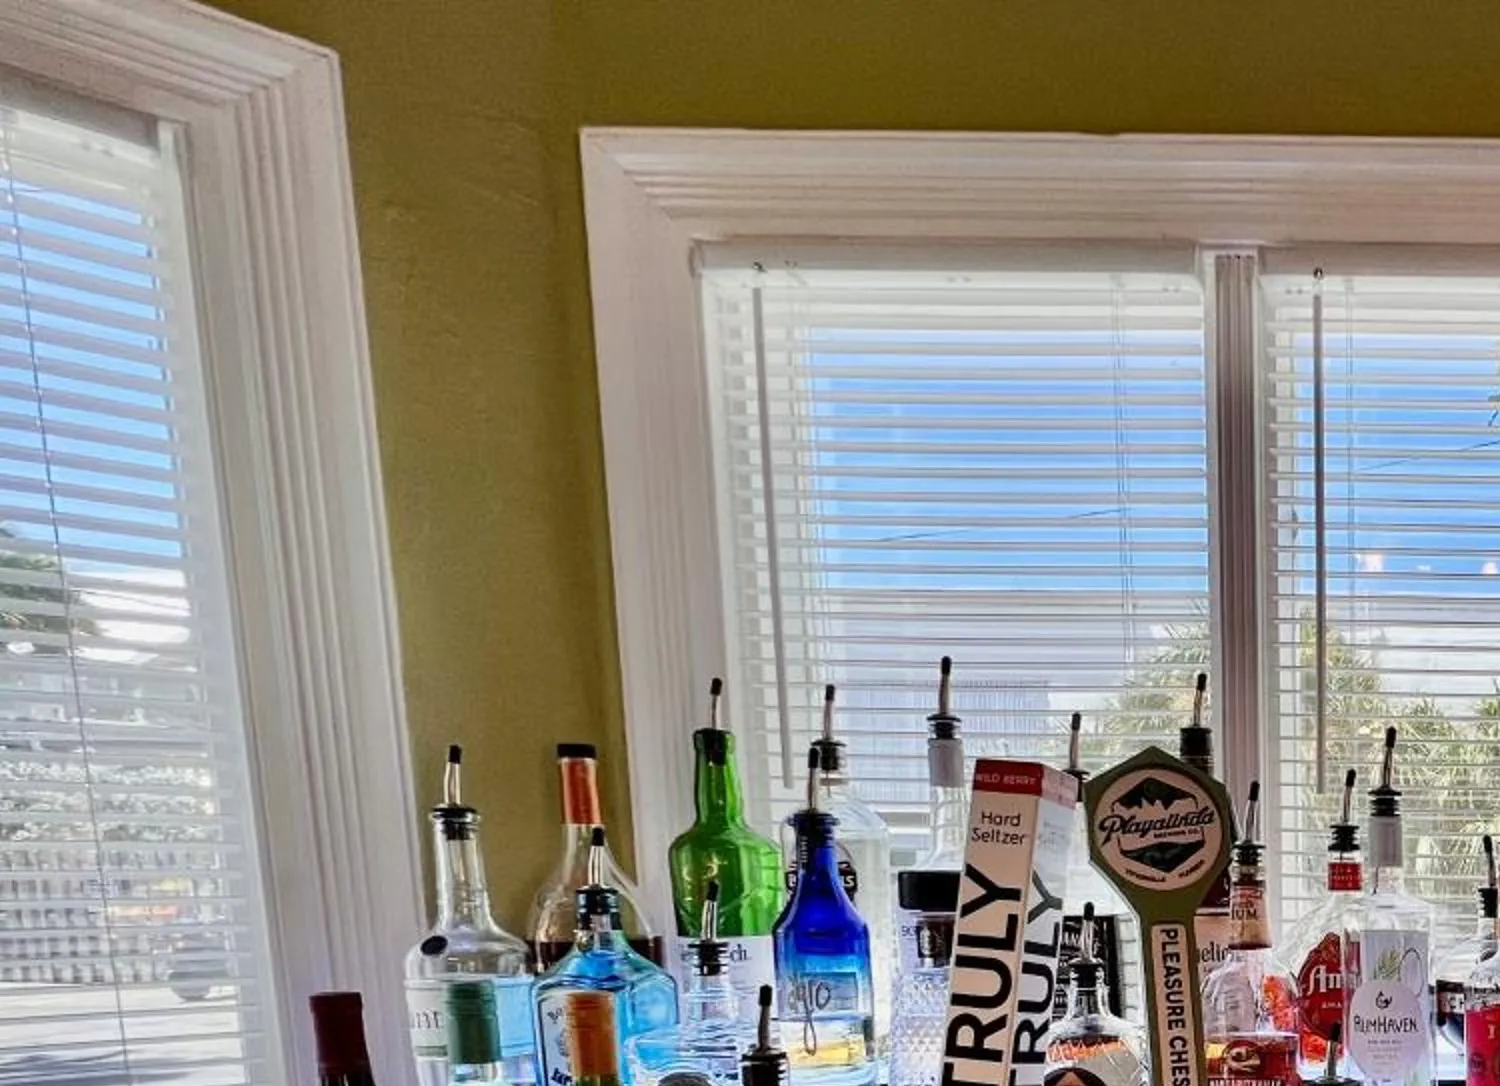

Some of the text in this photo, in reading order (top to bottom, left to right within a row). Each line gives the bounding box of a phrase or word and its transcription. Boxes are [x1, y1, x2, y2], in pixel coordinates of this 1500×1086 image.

[981, 811, 1022, 827] Hard
[1098, 805, 1215, 846] Playalinda
[971, 827, 1026, 846] Seltzer
[1158, 928, 1188, 1033] PLEASURE
